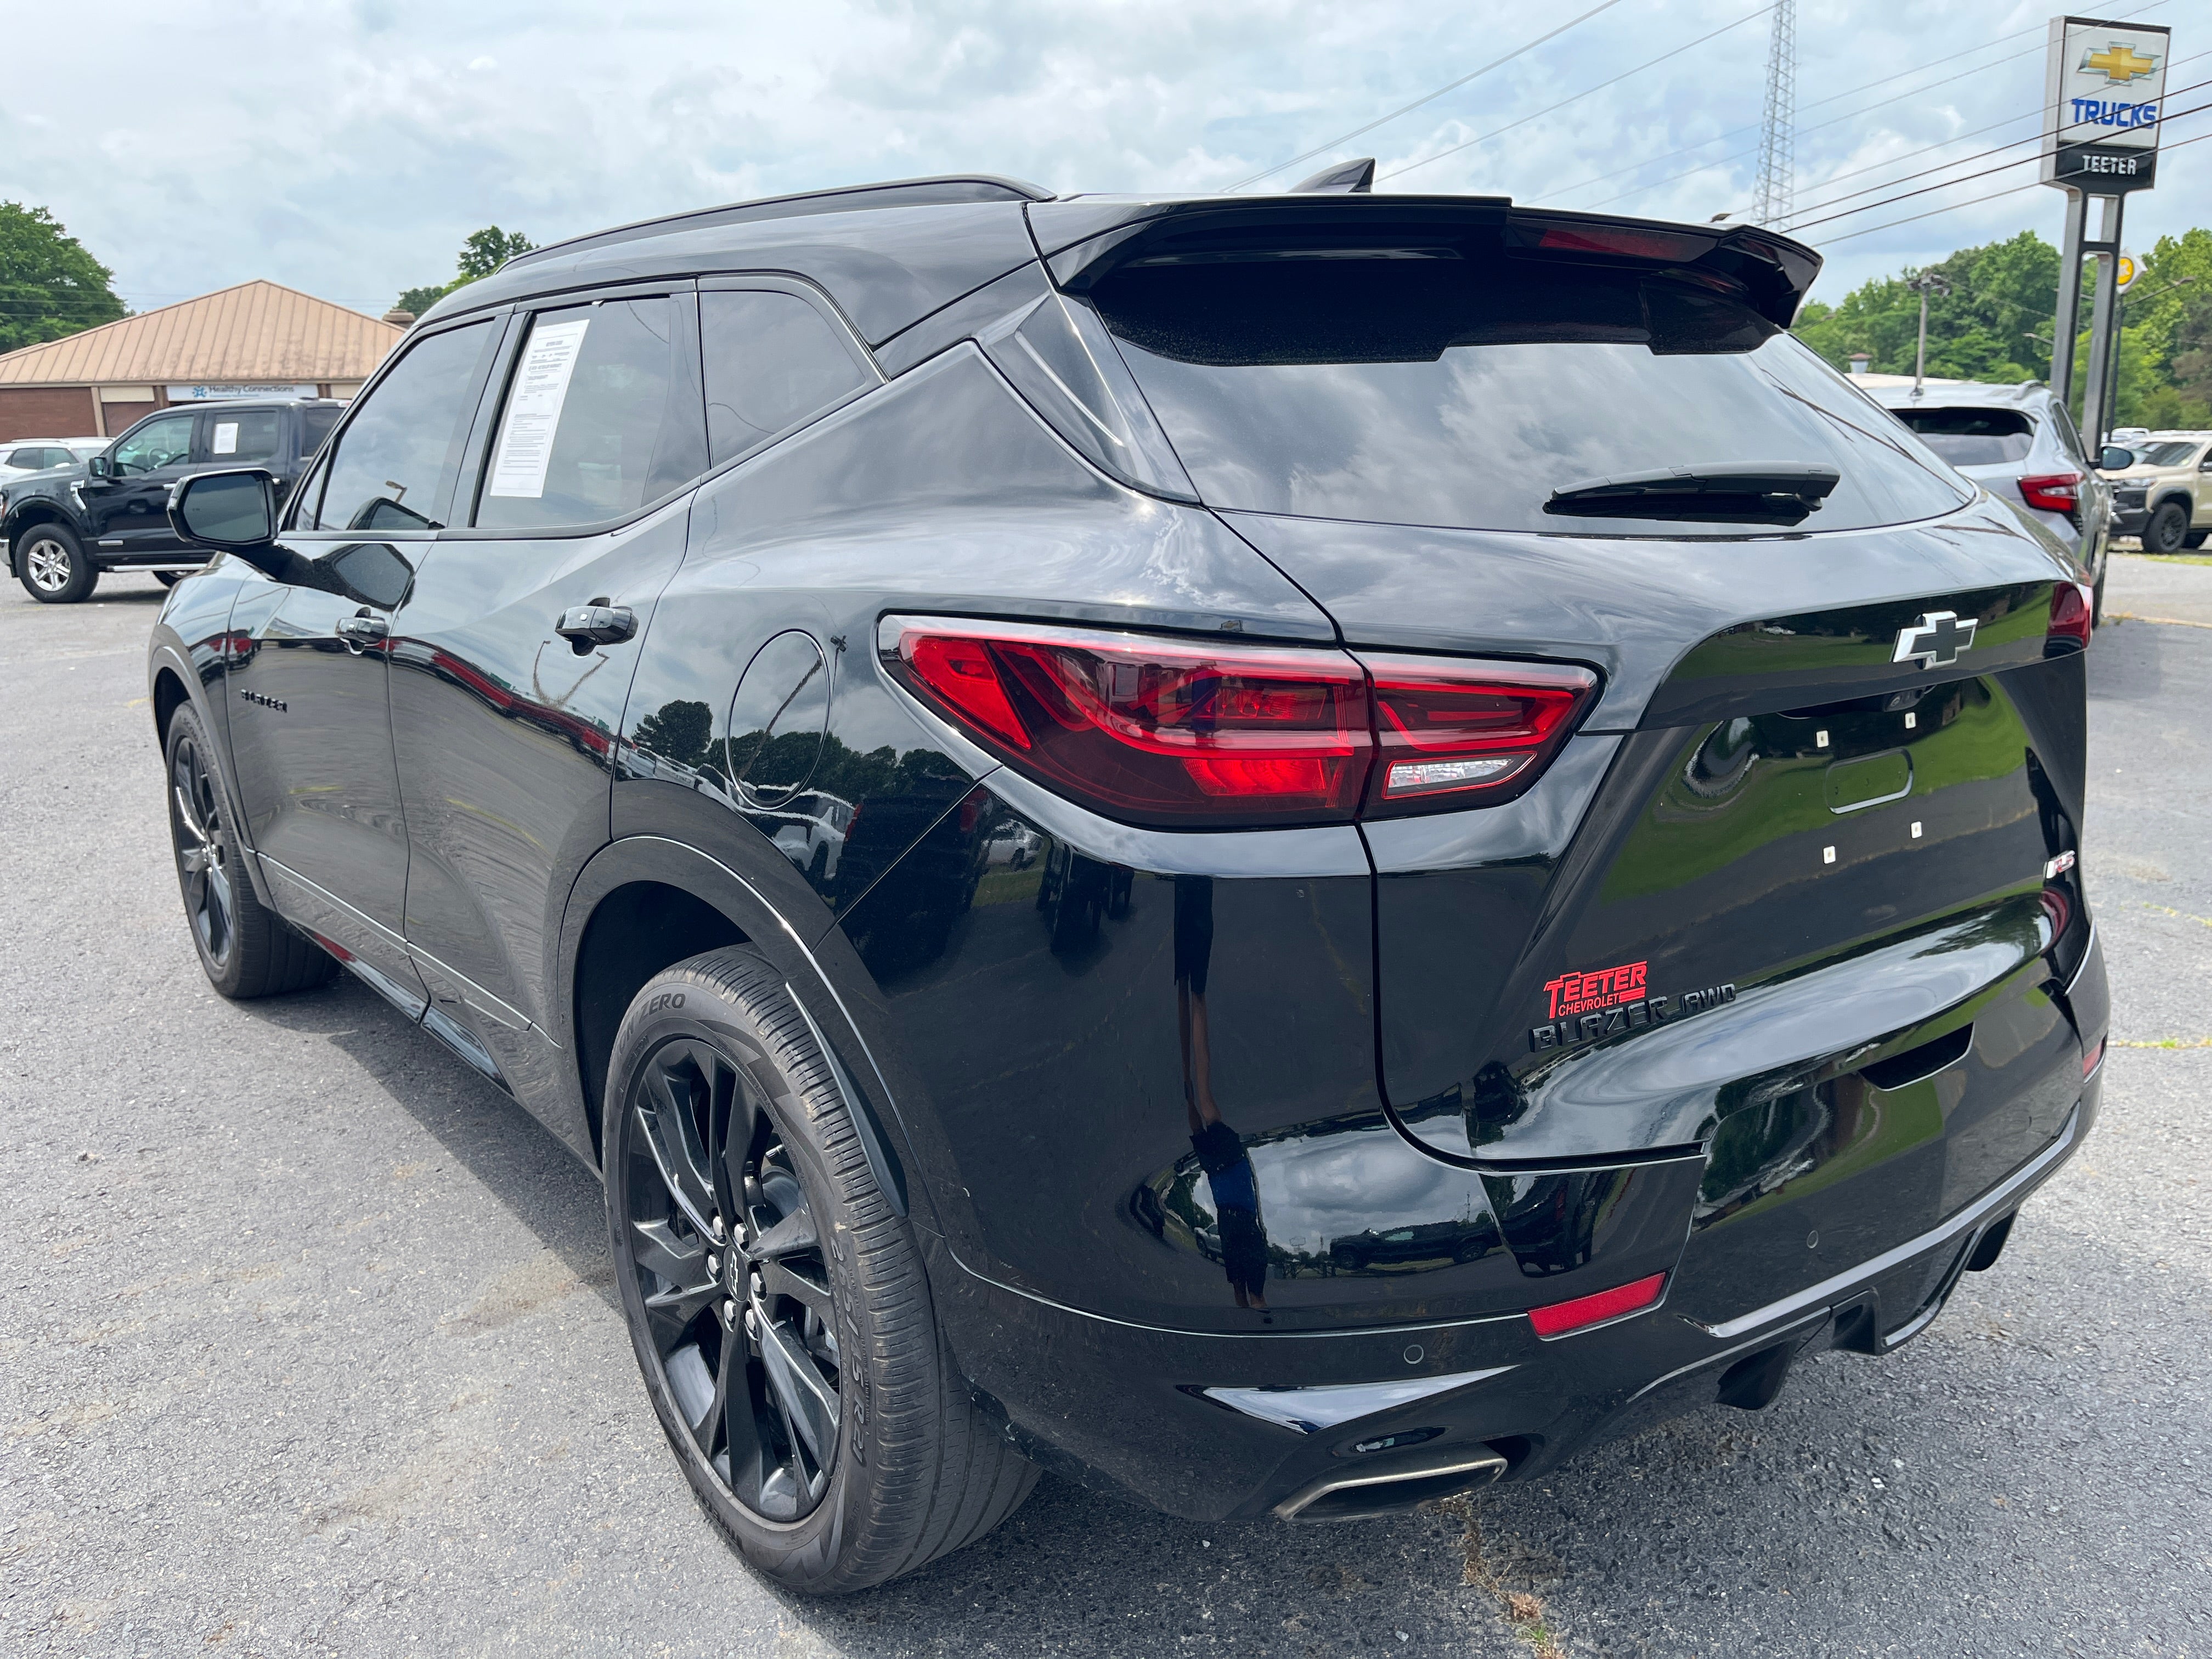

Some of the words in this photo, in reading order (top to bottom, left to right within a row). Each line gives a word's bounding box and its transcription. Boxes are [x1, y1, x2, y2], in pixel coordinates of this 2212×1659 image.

[2072, 98, 2157, 129] TRUCKS
[2082, 155, 2137, 176] TEETER
[1543, 962, 1647, 1019] TEETER
[1559, 992, 1620, 1017] CHEVROLET
[639, 993, 686, 1024] ZERO
[1528, 996, 1668, 1053] BLAZER
[1680, 984, 1736, 1013] AWD
